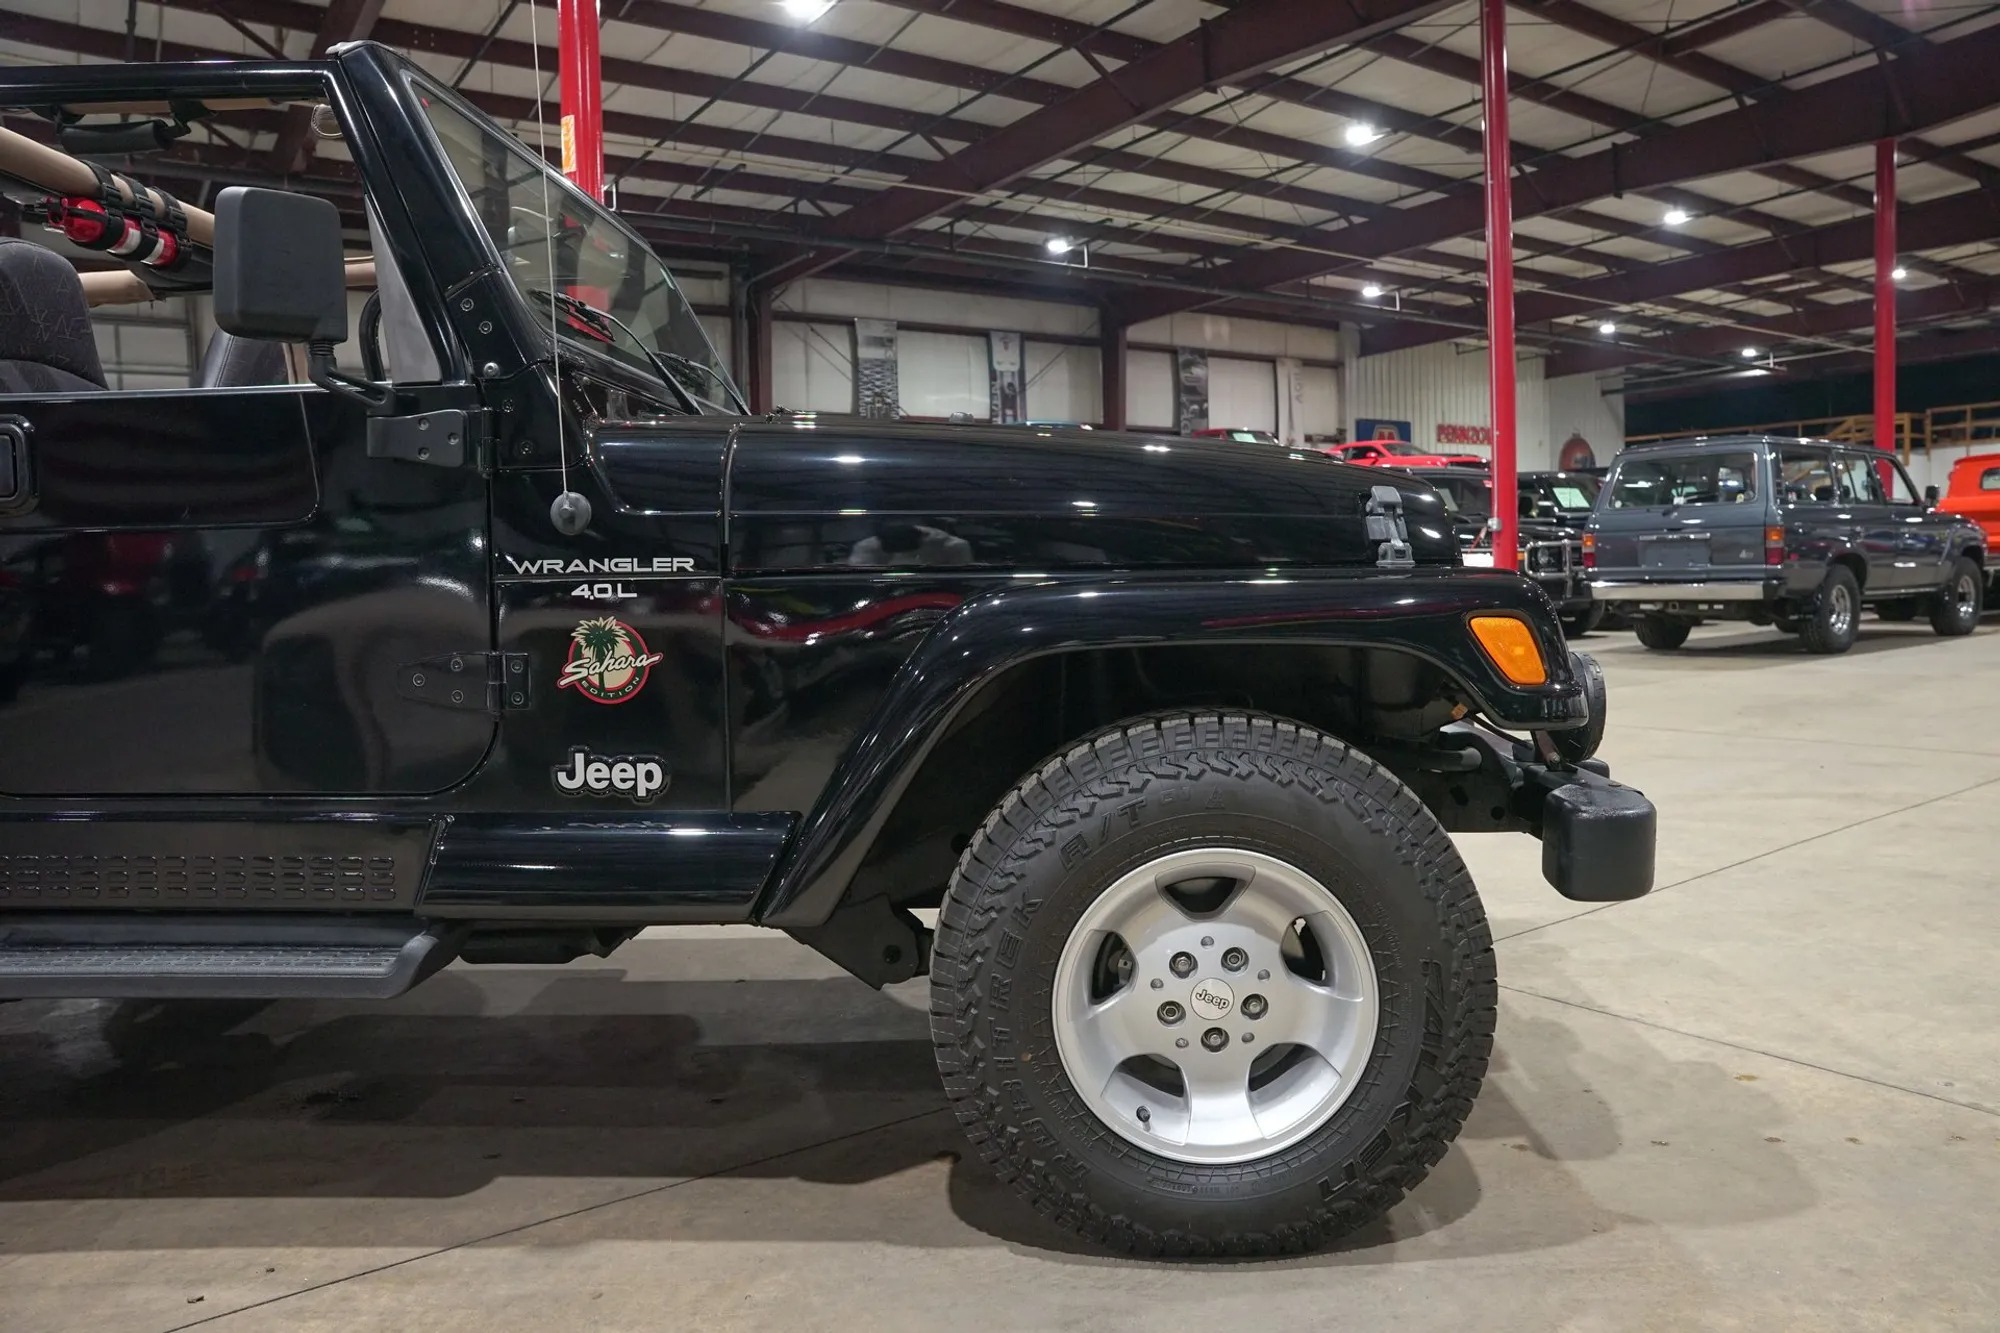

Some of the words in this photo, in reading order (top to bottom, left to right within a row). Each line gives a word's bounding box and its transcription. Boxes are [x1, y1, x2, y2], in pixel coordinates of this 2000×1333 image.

[510, 557, 695, 574] WRANGLER
[560, 650, 661, 686] Sahara
[580, 676, 641, 698] EDITION
[557, 753, 664, 797] Jeep
[1195, 988, 1230, 1010] Jeep
